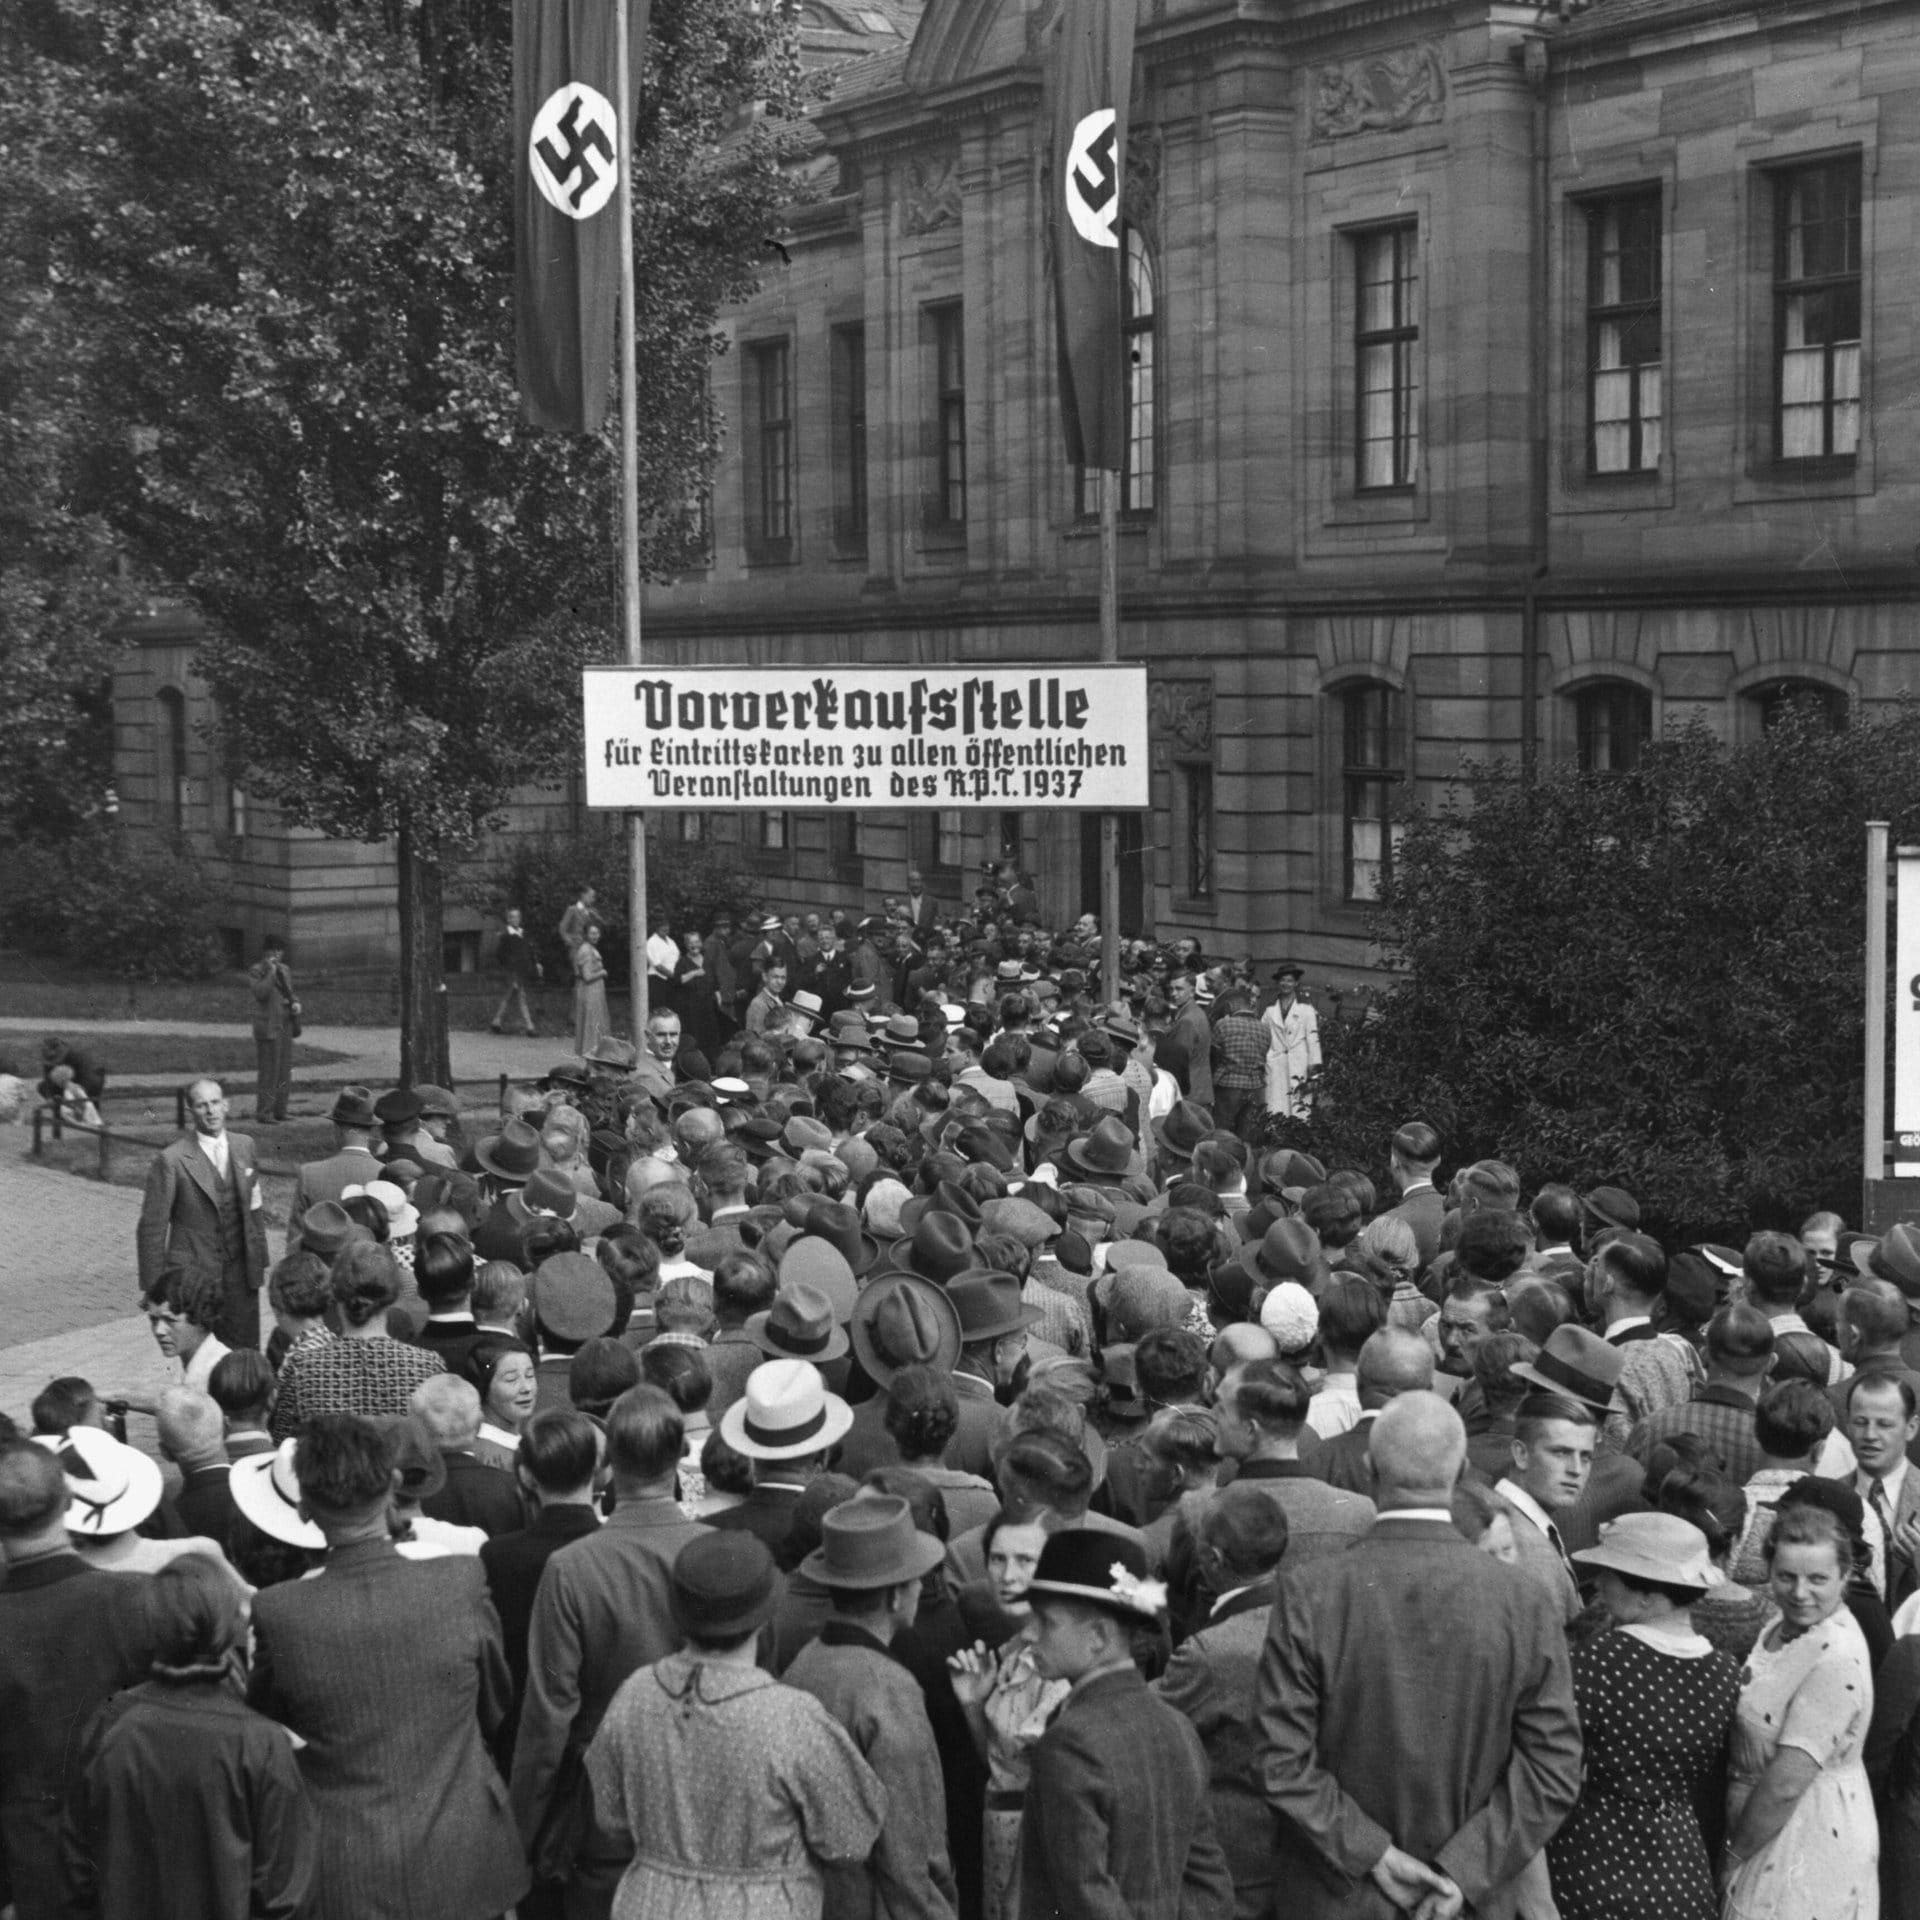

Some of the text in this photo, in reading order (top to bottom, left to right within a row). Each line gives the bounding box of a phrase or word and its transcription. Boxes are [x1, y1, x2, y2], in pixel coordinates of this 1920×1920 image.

[604, 737, 1127, 770] für Eintrittskarten zu allen öffentlichen
[890, 770, 938, 798] des
